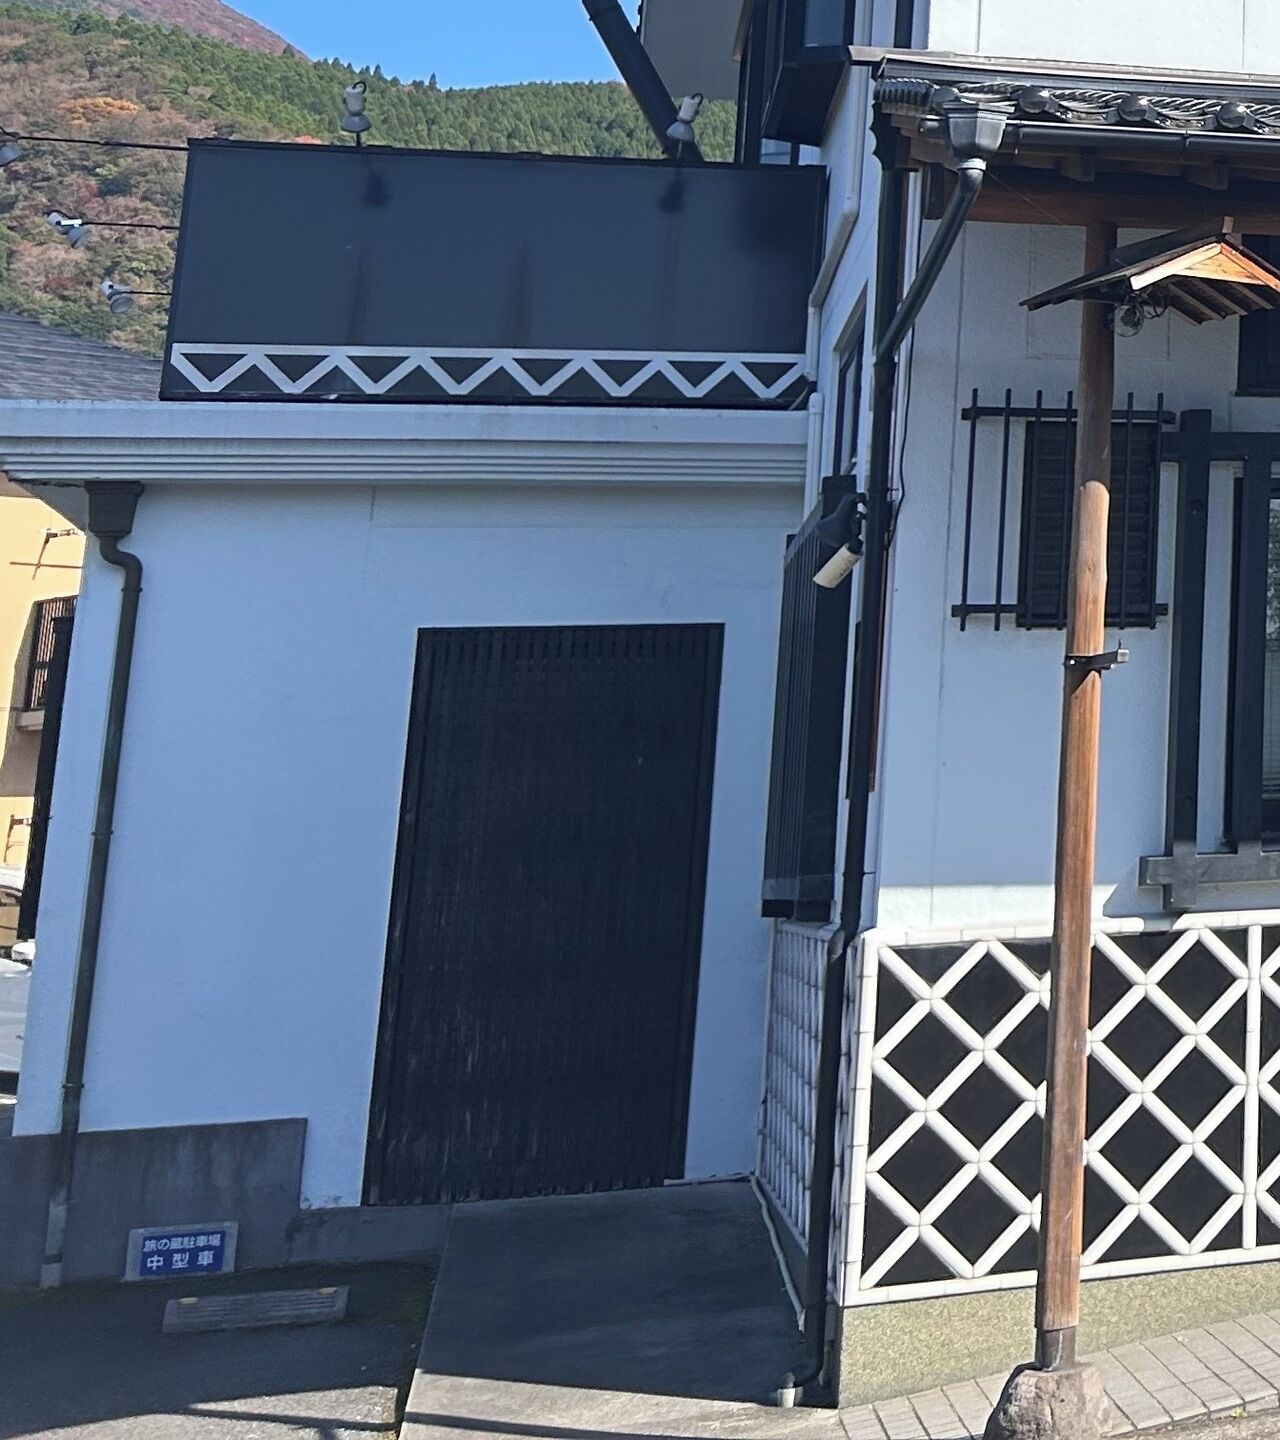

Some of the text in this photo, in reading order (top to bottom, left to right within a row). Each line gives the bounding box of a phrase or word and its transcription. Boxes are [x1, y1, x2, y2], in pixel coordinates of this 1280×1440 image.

[143, 1233, 221, 1253] 旅の蔵駐車場
[147, 1250, 216, 1271] 中型車
